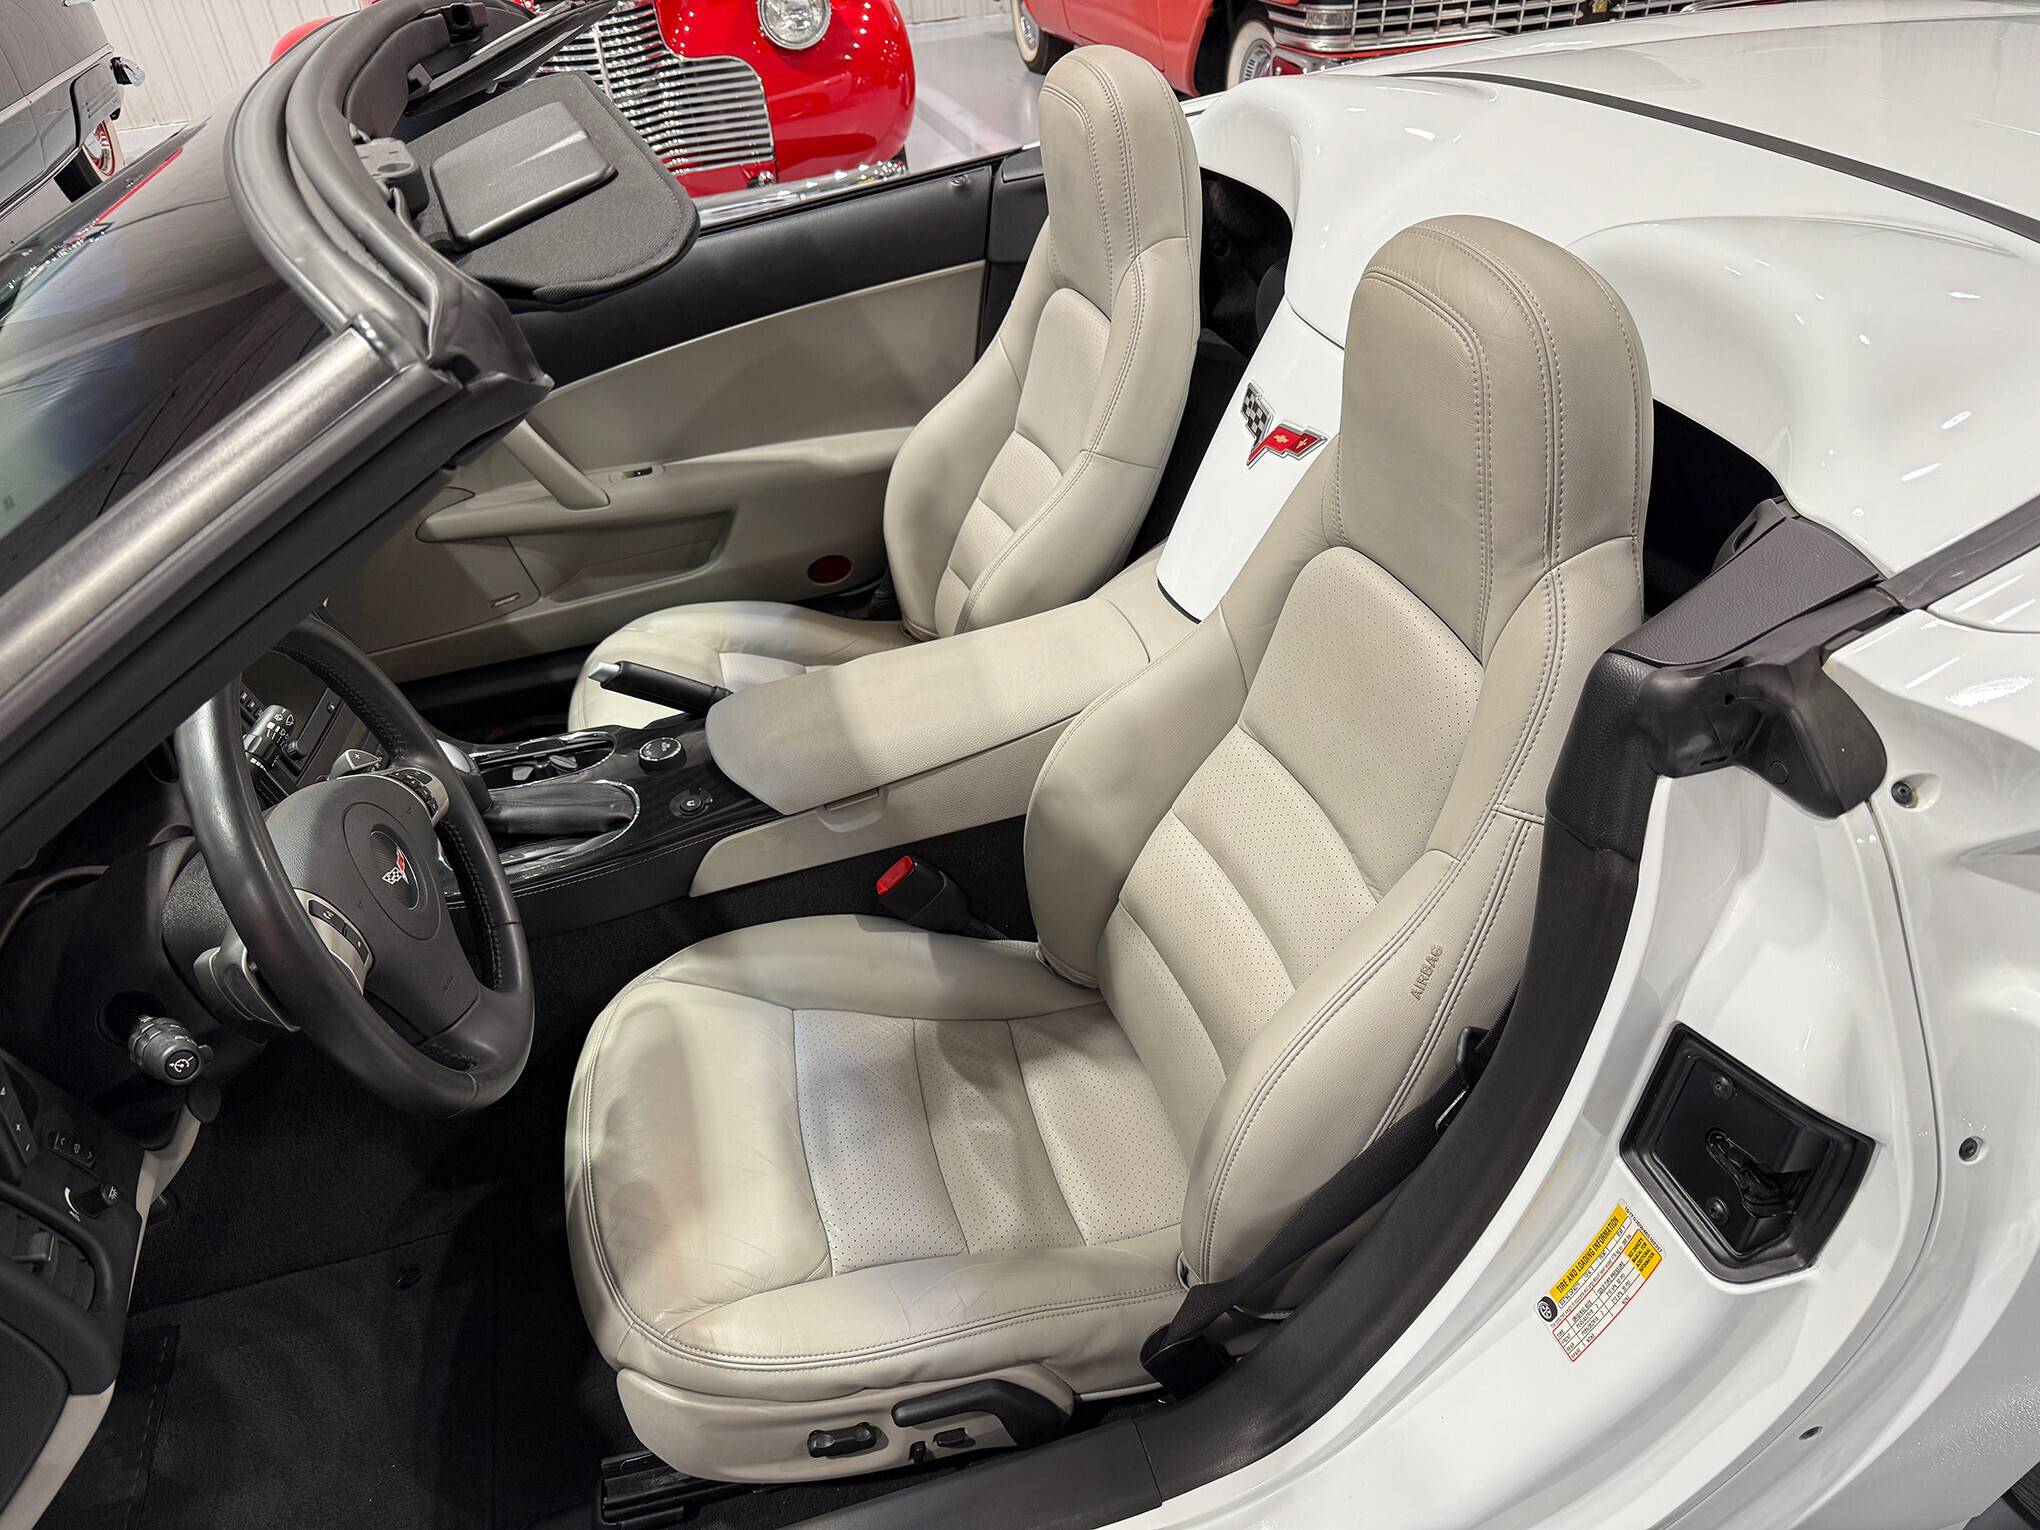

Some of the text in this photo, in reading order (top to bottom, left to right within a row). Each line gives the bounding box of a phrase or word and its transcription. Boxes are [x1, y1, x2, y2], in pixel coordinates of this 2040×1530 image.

[1410, 944, 1443, 1001] AIRBAG
[1556, 1278, 1569, 1293] TIRE
[1565, 1268, 1578, 1283] AND
[1575, 1247, 1595, 1272] LOADING
[1591, 1215, 1619, 1251] INFORMATION
